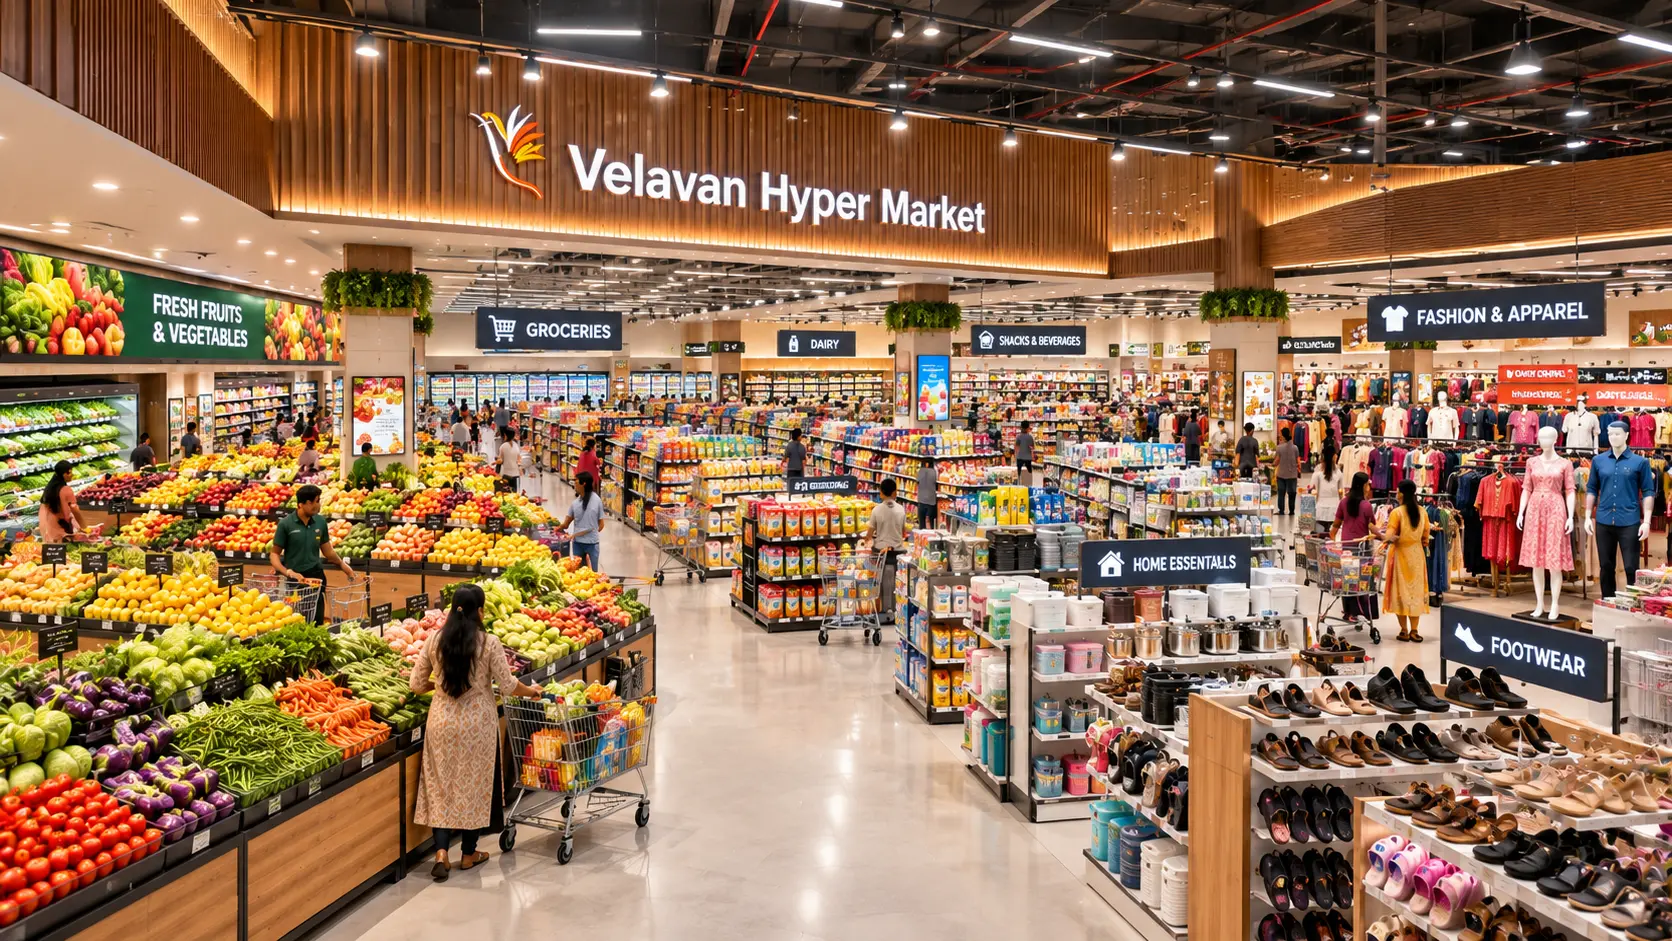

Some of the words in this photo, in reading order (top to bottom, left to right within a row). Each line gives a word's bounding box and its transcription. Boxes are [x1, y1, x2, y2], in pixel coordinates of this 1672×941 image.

[568, 144, 746, 208] Velavan
[761, 171, 871, 225] Hyper
[882, 188, 985, 234] Market
[153, 293, 198, 319] FRESH
[201, 301, 243, 323] FRUITS
[1417, 306, 1486, 326] FASHION
[1490, 305, 1504, 323] &
[1507, 301, 1589, 322] APPAREL
[152, 322, 166, 343] &
[169, 322, 248, 348] VEGETABLES
[526, 322, 611, 339] GROCERIES
[1031, 335, 1038, 346] &
[1038, 335, 1081, 346] BEVERAGES
[810, 339, 840, 350] DAIRY
[1133, 556, 1168, 572] HOME
[1491, 636, 1587, 678] FOOTWEAR
